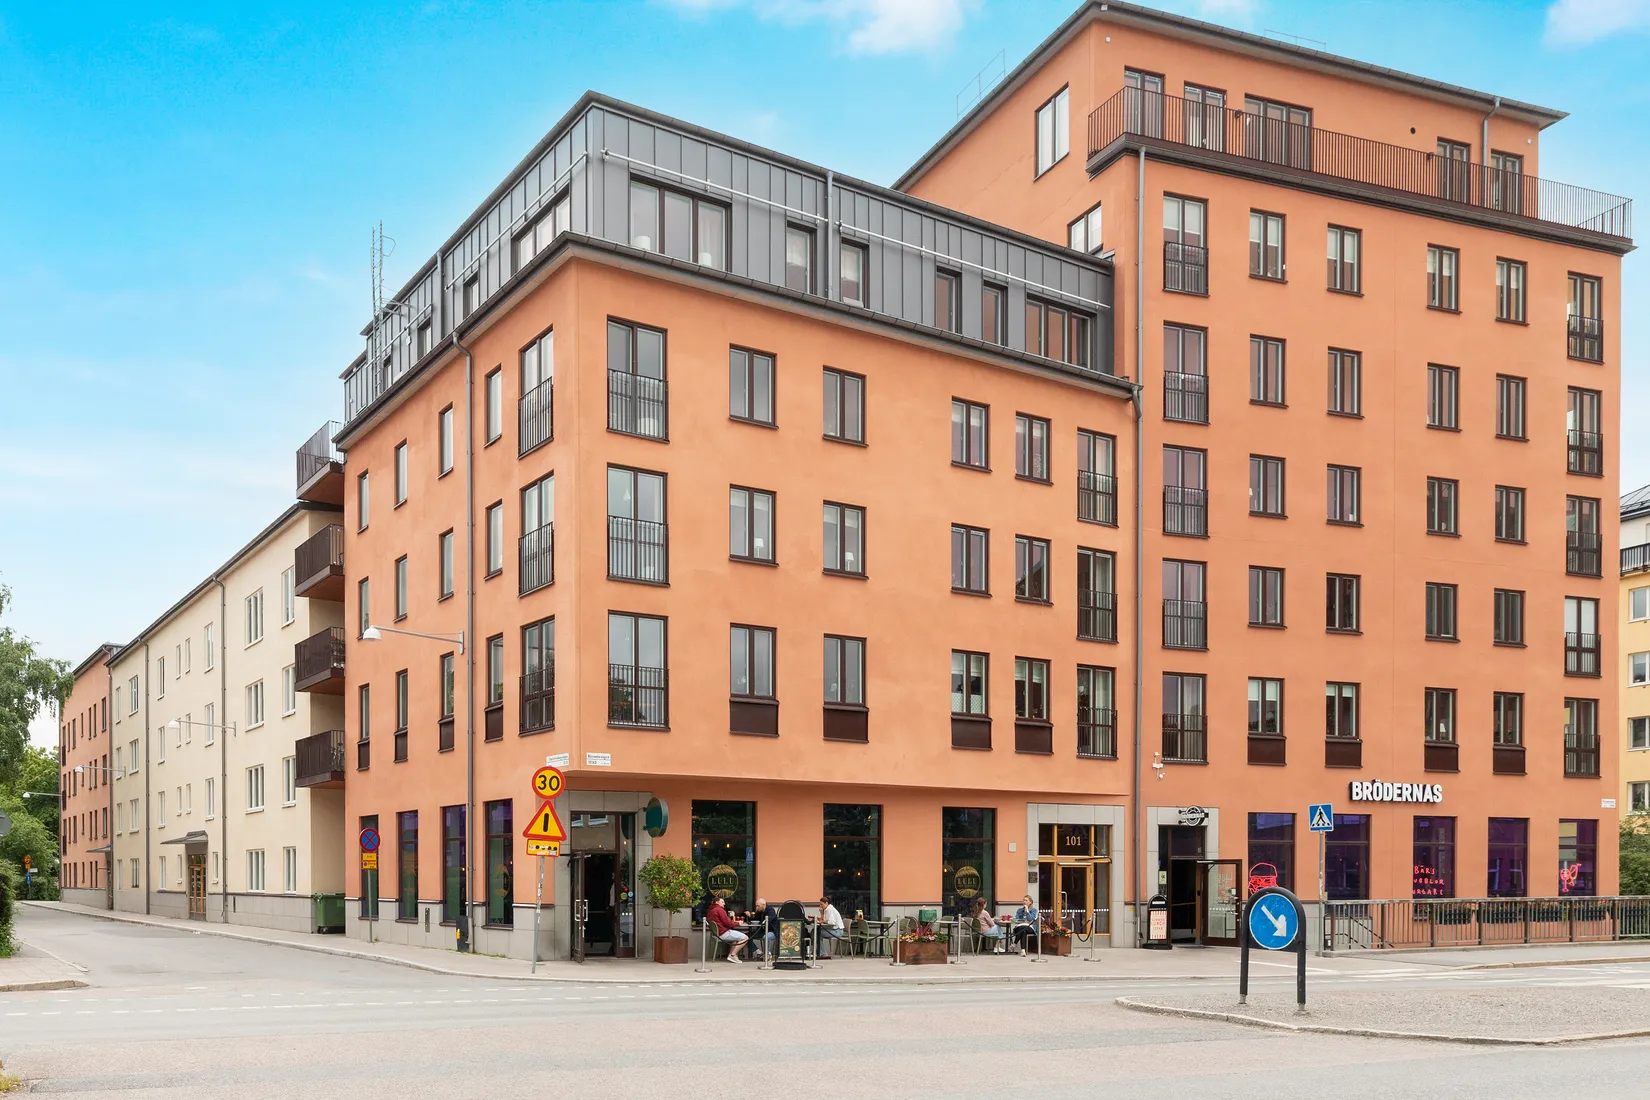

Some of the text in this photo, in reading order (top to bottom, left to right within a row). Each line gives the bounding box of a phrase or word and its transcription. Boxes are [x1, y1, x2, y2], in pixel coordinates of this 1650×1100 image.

[537, 774, 560, 791] 30
[1350, 779, 1443, 803] BRÖDERNAS
[1065, 835, 1081, 846] 101
[711, 877, 733, 885] LULU
[957, 877, 977, 885] LULU
